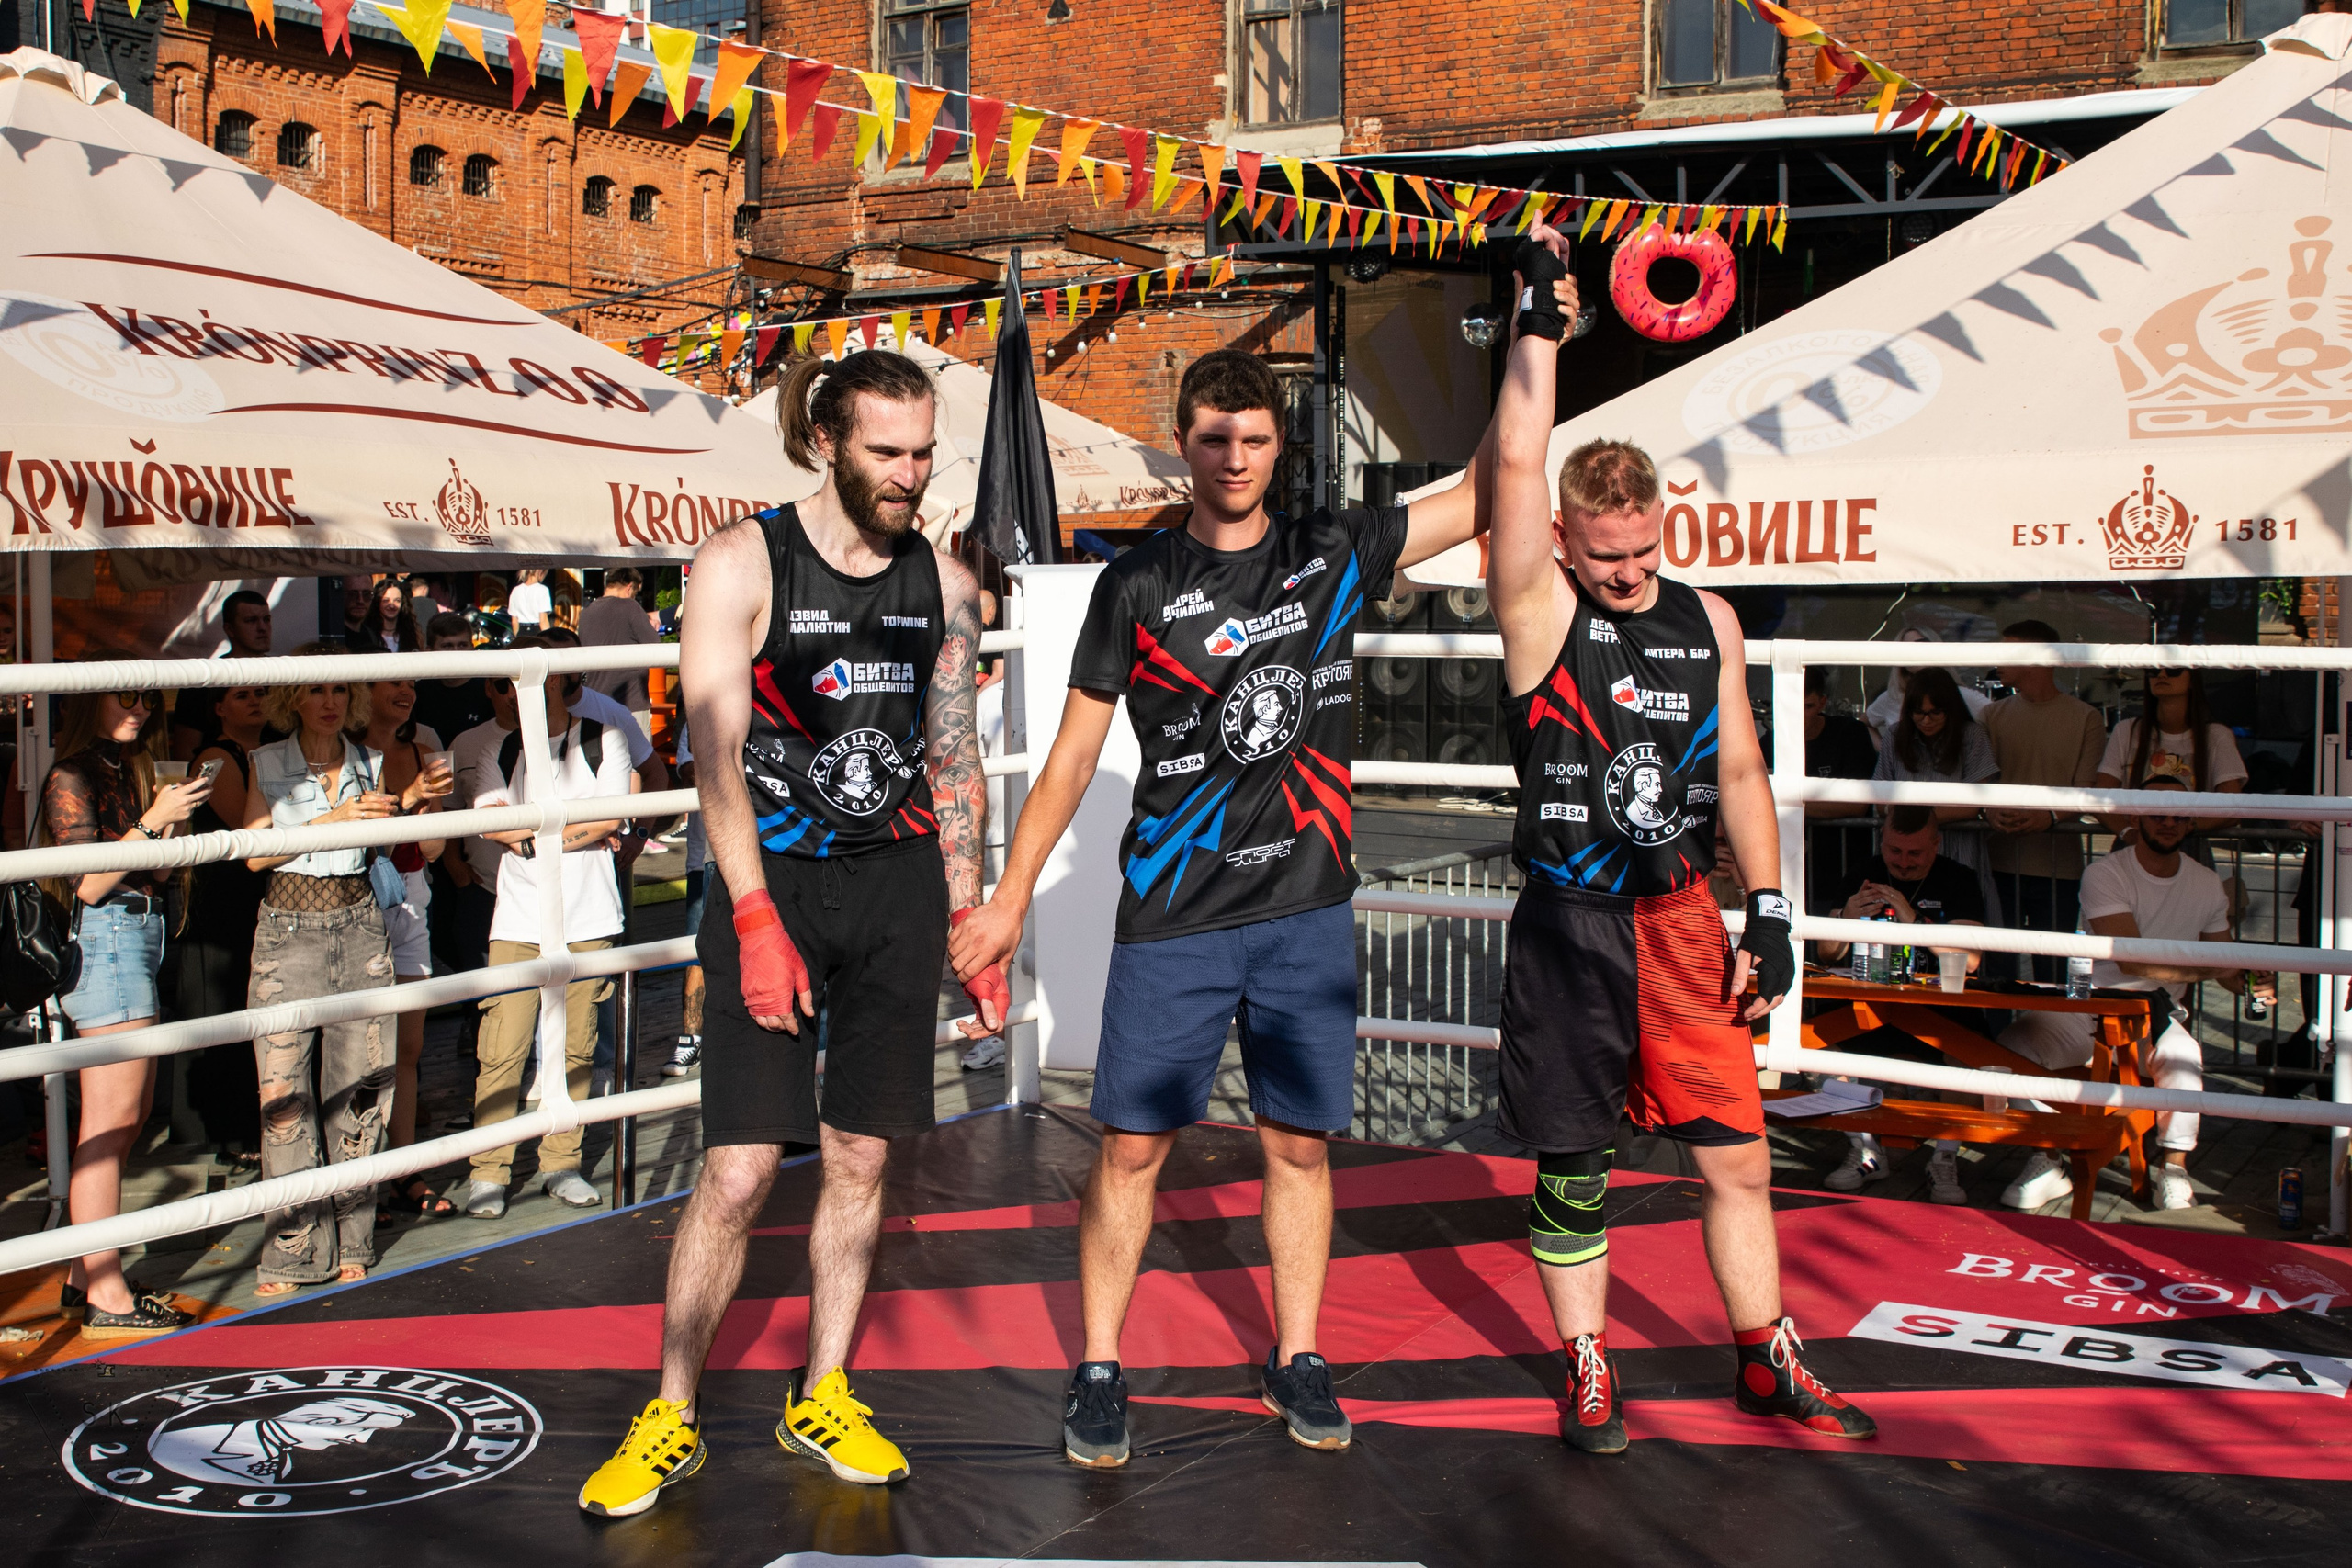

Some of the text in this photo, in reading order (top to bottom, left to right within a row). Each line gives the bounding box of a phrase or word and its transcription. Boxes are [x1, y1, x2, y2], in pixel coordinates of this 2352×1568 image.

[1701, 334, 1931, 396] БЕЗАЛКОГОЬНАЯ
[383, 502, 541, 527] EST. 1581
[2012, 517, 2299, 547] EST. 1581
[1245, 601, 1306, 635] БИТВА
[1690, 649, 1711, 660] БАР
[853, 661, 915, 682] БИТВА
[1324, 694, 1352, 705] LADOG
[1636, 688, 1690, 711] ИТВА
[812, 732, 901, 784] КАНЦЛЕР
[1544, 763, 1589, 777] BROOM
[833, 789, 882, 810] 2010
[1544, 806, 1585, 818] SIBSA
[1623, 819, 1676, 840] 2010
[1946, 1252, 2334, 1317] BROOM
[2062, 1294, 2180, 1318] GIN
[1893, 1314, 2318, 1387] SIBSA
[90, 1442, 292, 1507] 2010
